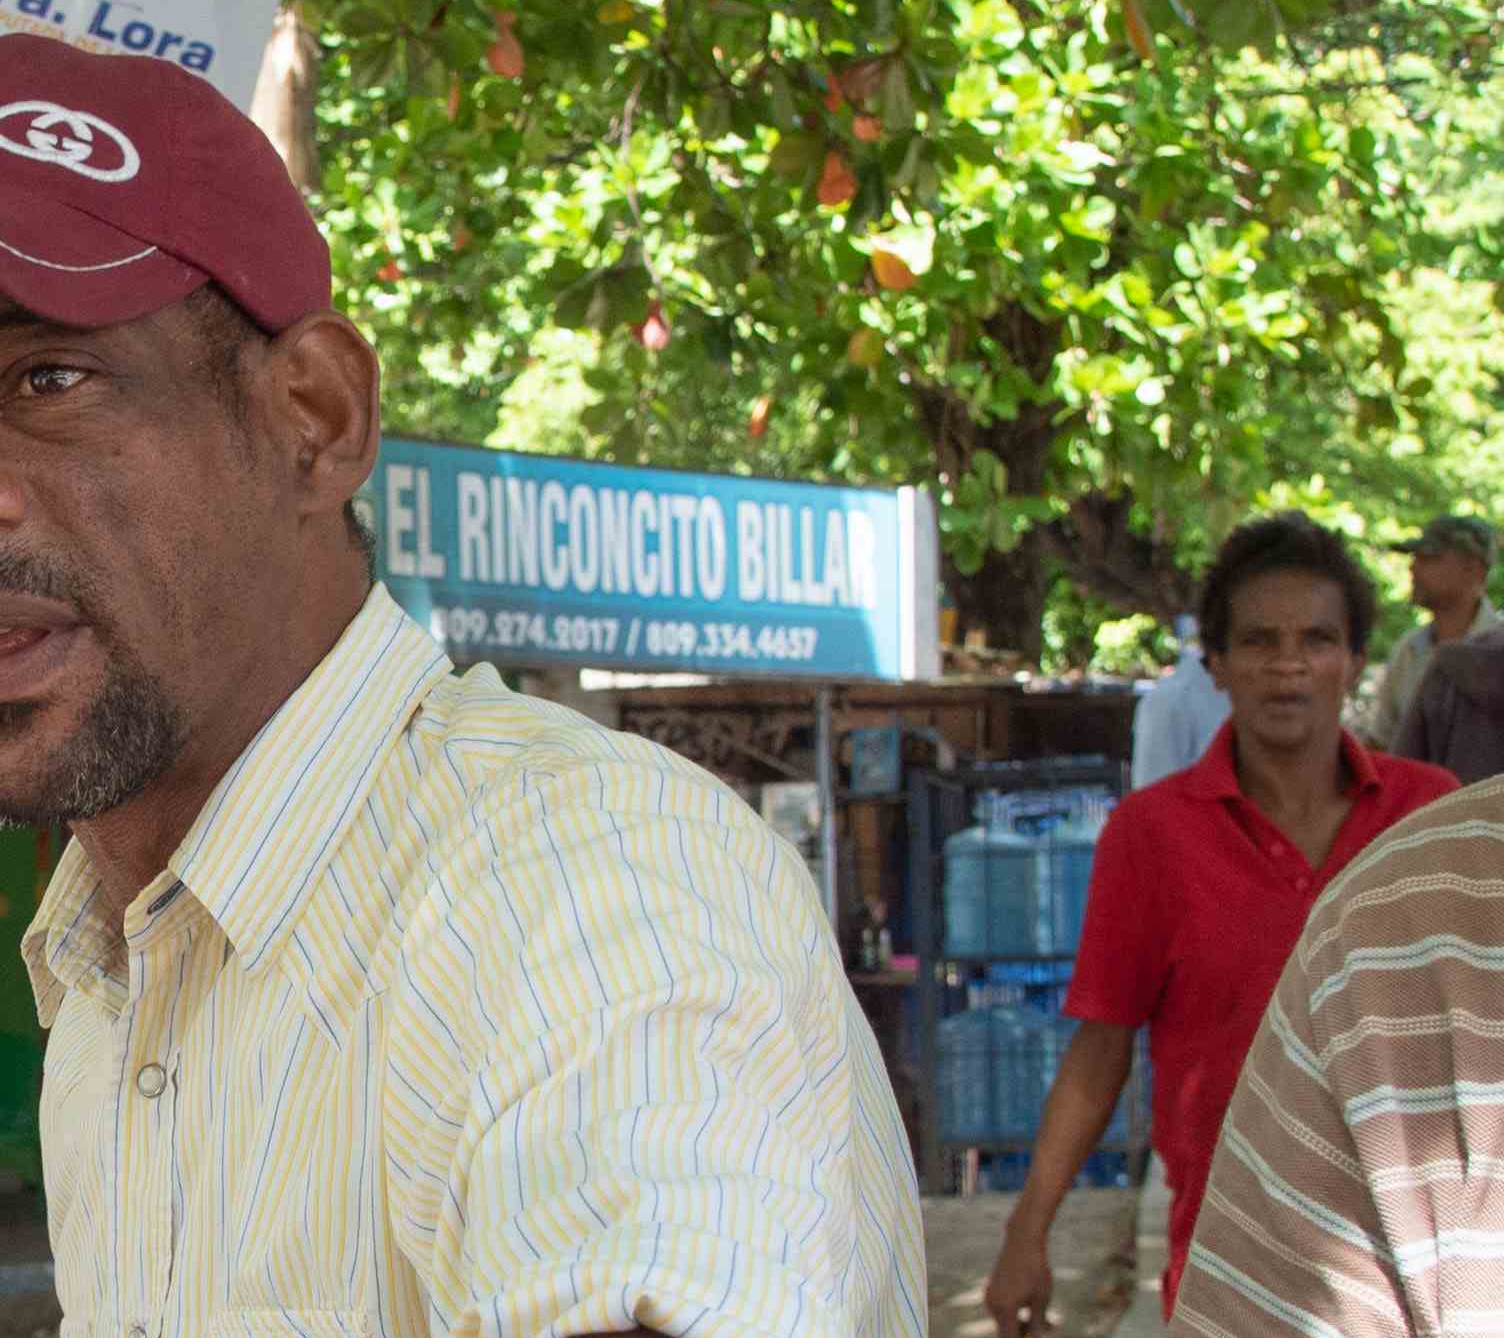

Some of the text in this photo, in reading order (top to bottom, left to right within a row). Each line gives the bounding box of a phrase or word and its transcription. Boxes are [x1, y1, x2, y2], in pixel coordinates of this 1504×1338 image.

[88, 0, 217, 73] Lora
[384, 464, 877, 609] EL RINCONCITO BILLAR
